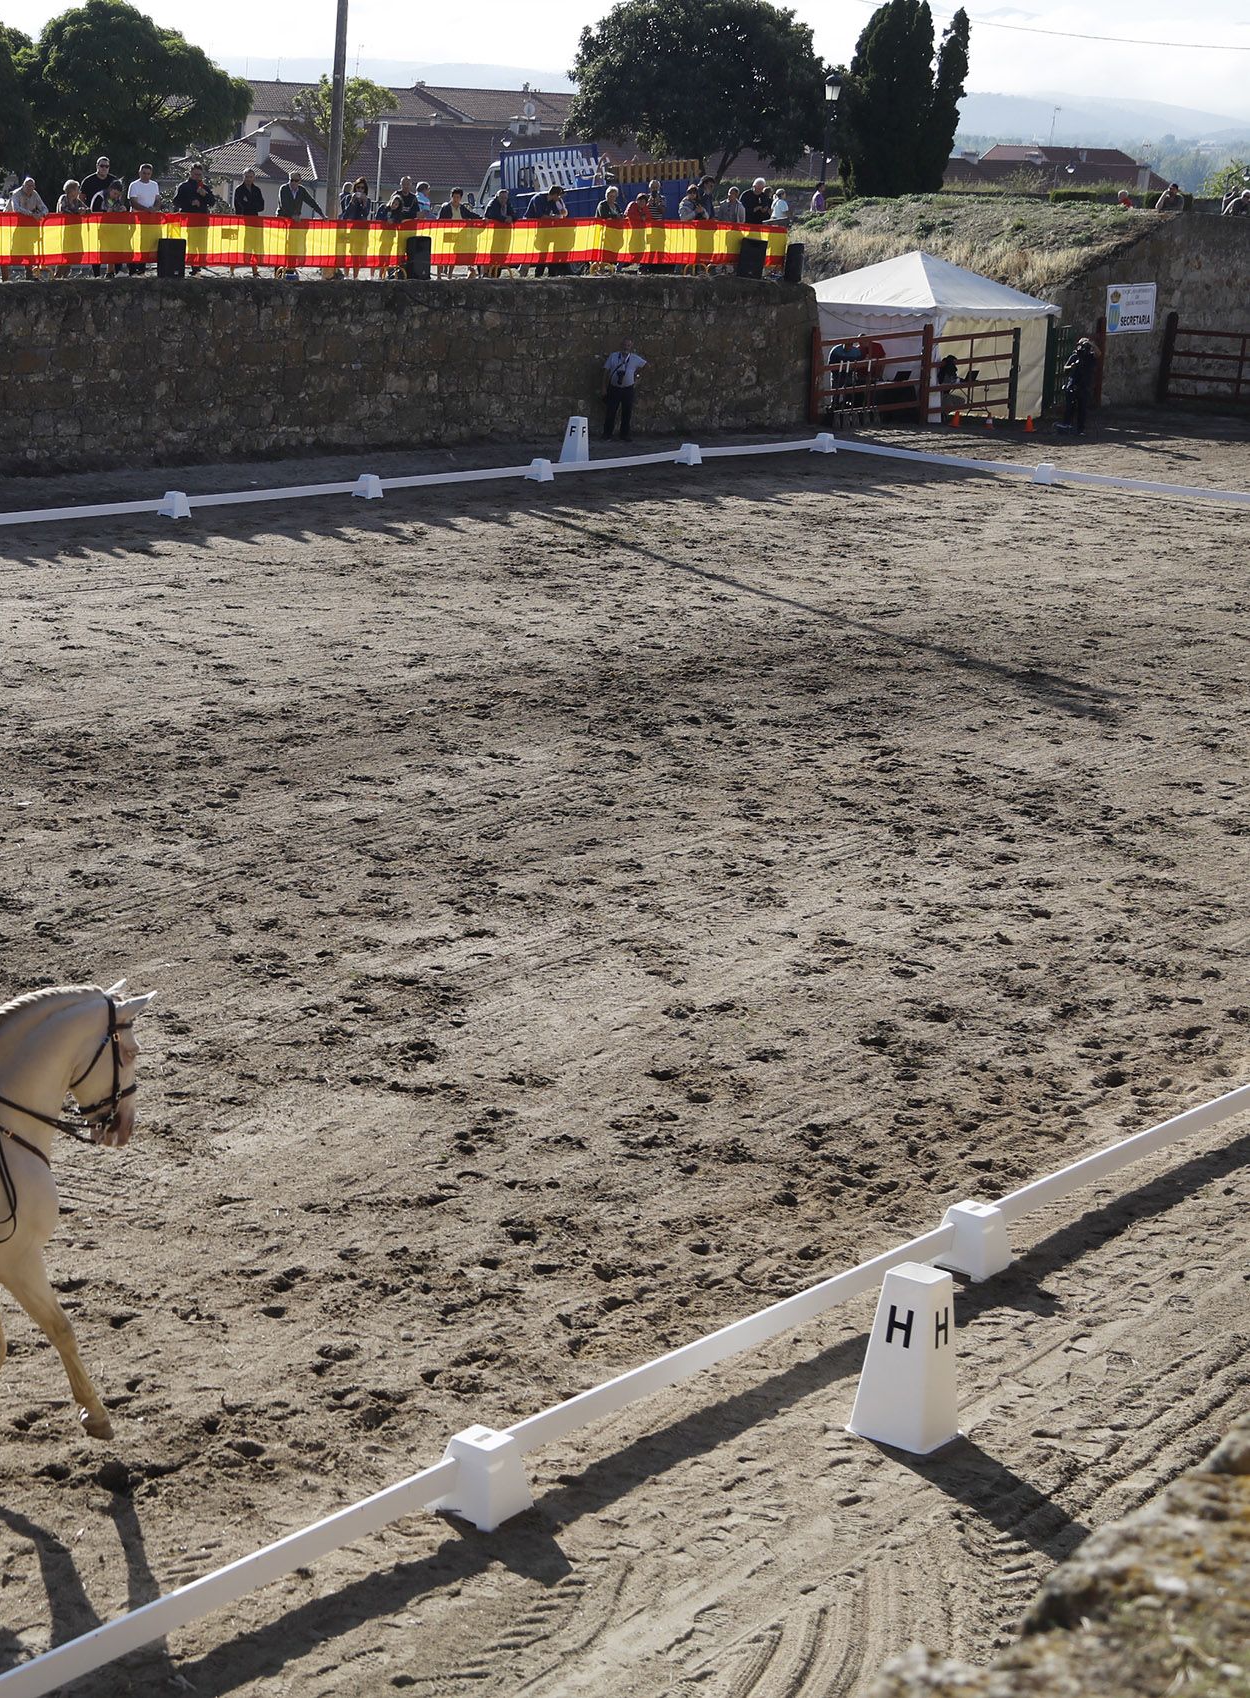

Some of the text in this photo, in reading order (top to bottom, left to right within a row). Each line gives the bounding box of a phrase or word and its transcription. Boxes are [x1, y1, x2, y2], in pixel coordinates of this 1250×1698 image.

[1120, 315, 1150, 327] SECRETARIA
[570, 425, 576, 437] F
[582, 426, 586, 438] F
[885, 1305, 914, 1349] H
[935, 1307, 948, 1349] H
